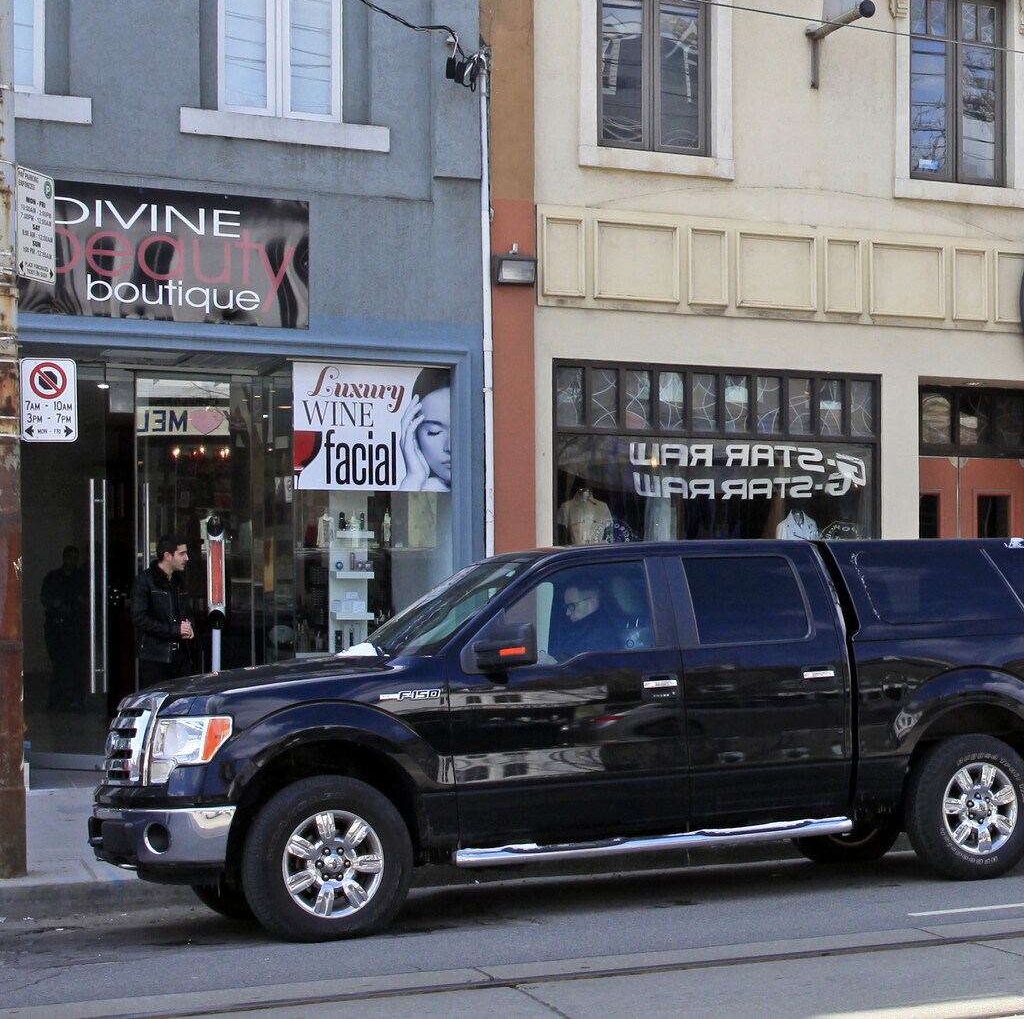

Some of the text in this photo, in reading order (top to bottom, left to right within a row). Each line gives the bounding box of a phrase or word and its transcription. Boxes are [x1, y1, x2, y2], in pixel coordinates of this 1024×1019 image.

[54, 196, 241, 238] DIVINE
[86, 274, 261, 314] boutique
[25, 401, 40, 411] 7AM
[53, 401, 73, 411] 10AM
[307, 366, 405, 413] Luxury
[26, 413, 43, 423] 3PM
[56, 413, 72, 423] 7PM
[303, 400, 374, 427] WINE
[324, 429, 397, 486] facial
